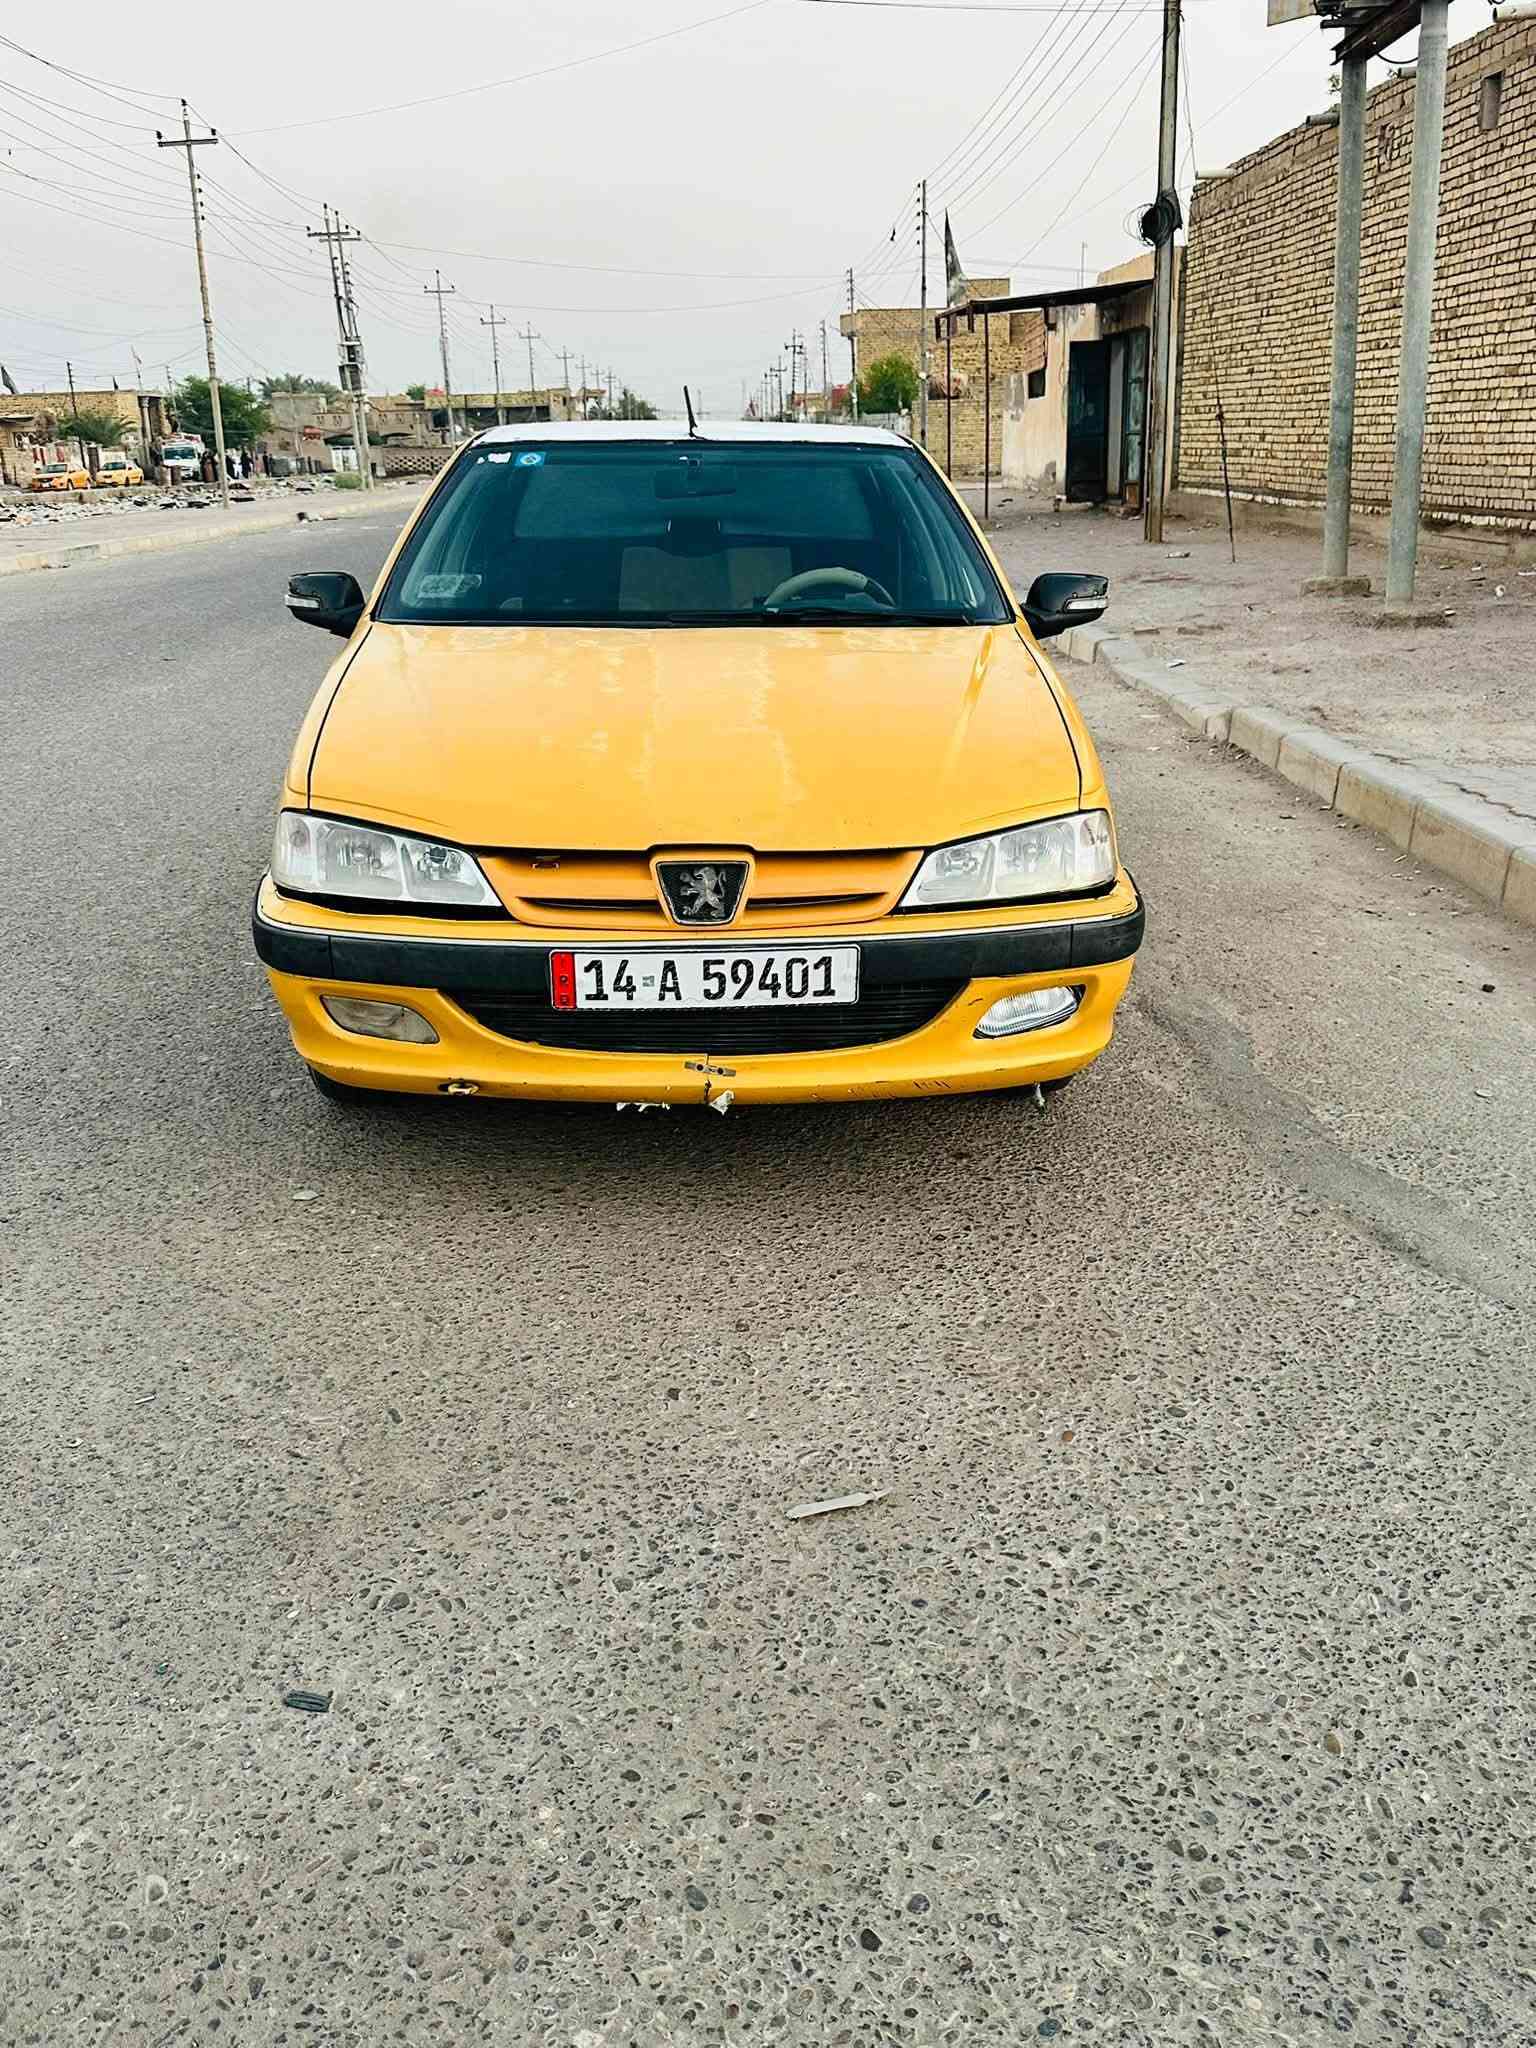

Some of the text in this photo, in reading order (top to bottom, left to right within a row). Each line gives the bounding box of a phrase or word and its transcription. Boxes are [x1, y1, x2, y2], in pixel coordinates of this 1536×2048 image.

[584, 959, 637, 1001] 14
[658, 959, 682, 1001] A
[702, 956, 836, 1000] 59401
